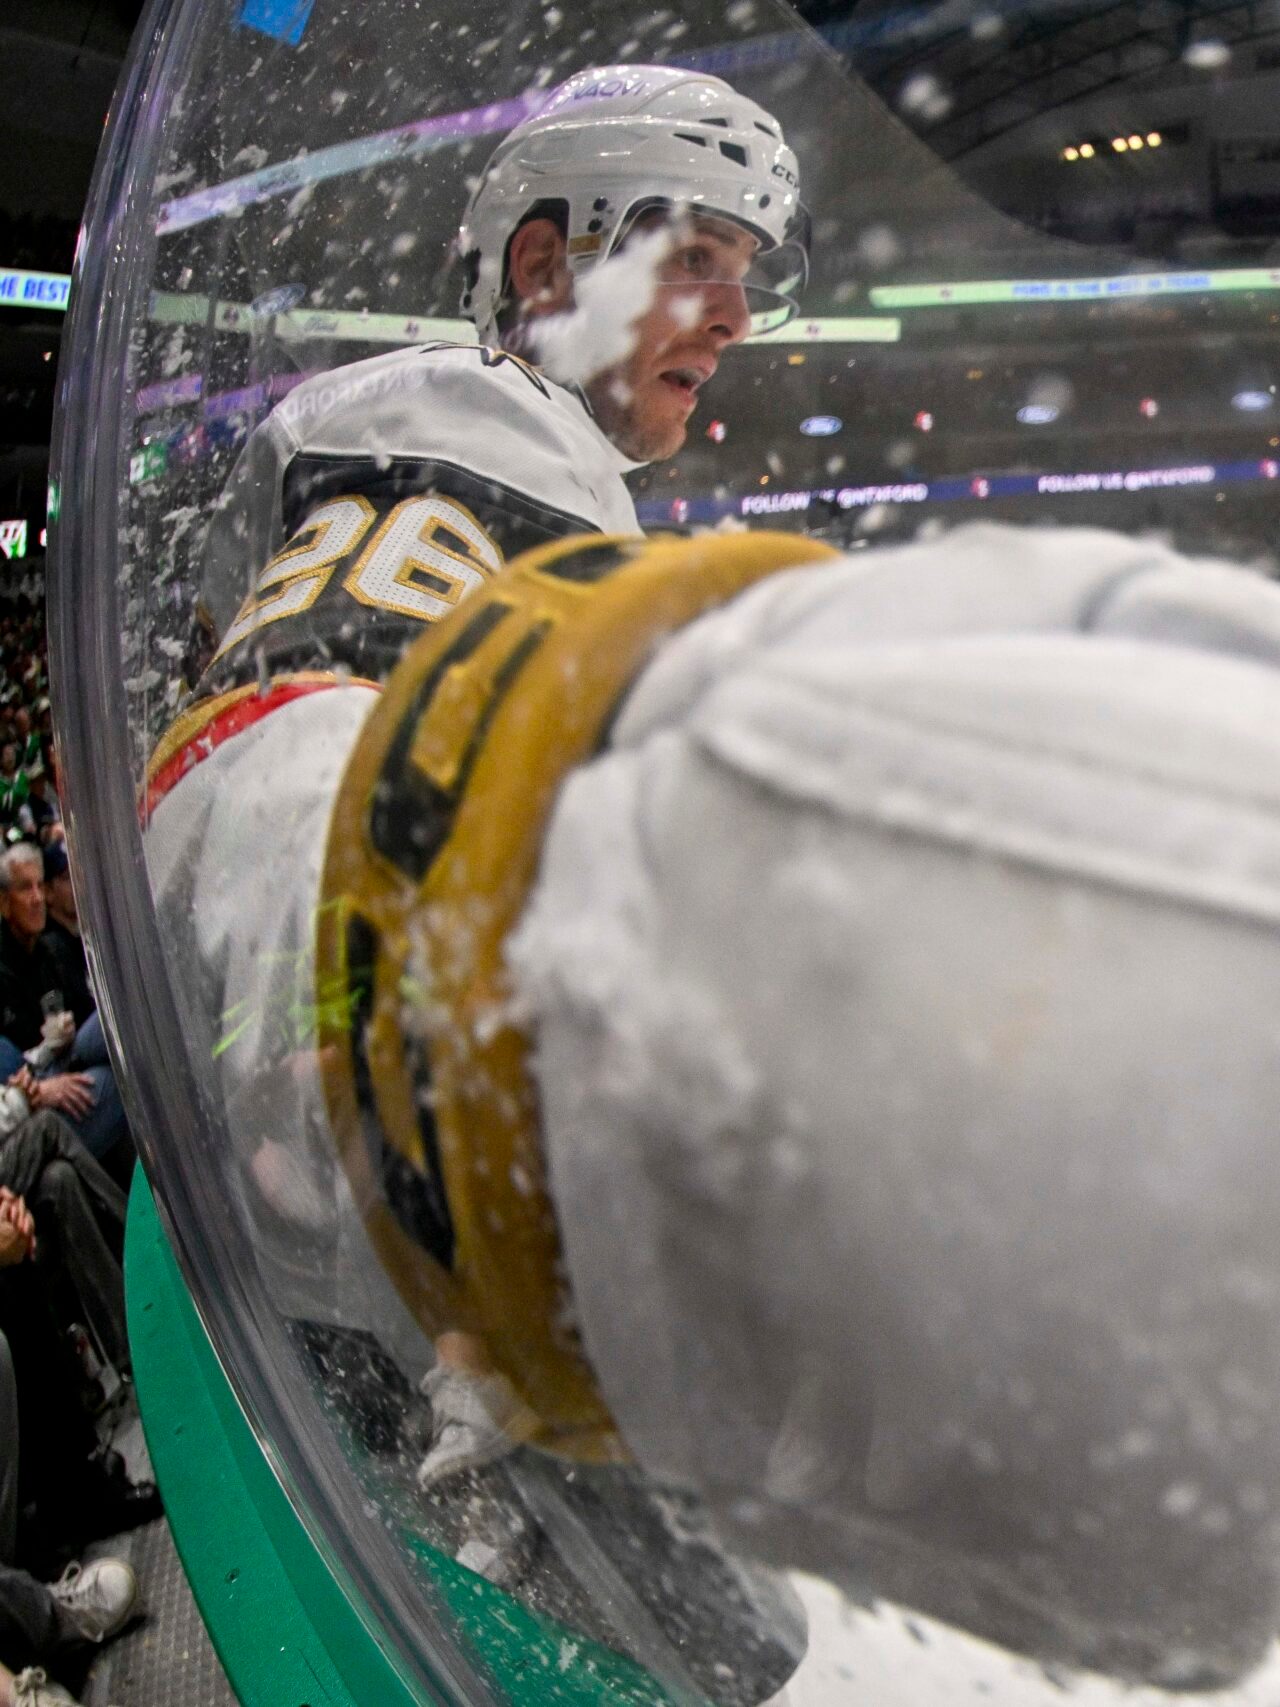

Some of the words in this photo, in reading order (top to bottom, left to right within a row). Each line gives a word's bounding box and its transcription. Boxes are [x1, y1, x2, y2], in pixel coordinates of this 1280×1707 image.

[24, 279, 69, 302] BEST
[742, 491, 811, 516] FOLLOW
[202, 493, 504, 677] 26
